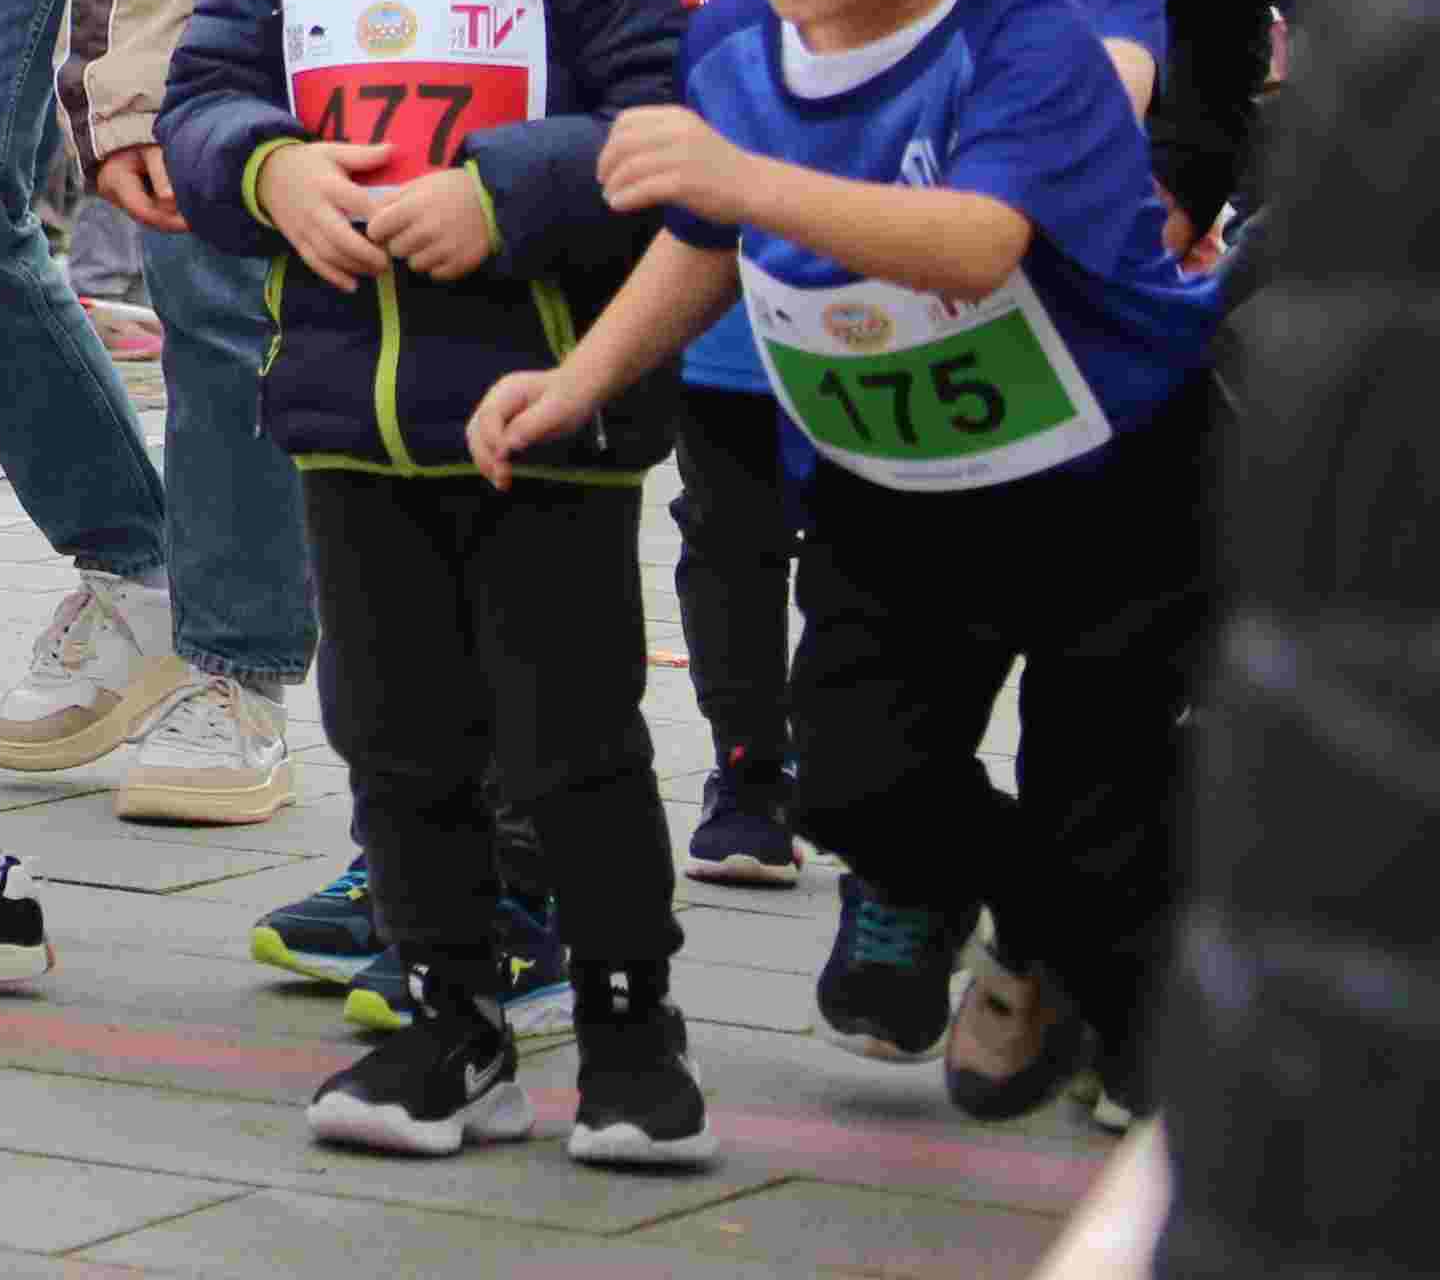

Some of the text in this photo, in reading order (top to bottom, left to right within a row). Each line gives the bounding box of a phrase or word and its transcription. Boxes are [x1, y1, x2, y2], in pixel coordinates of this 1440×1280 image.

[451, 4, 526, 49] TV
[310, 83, 473, 165] 477
[818, 351, 1006, 445] 175
